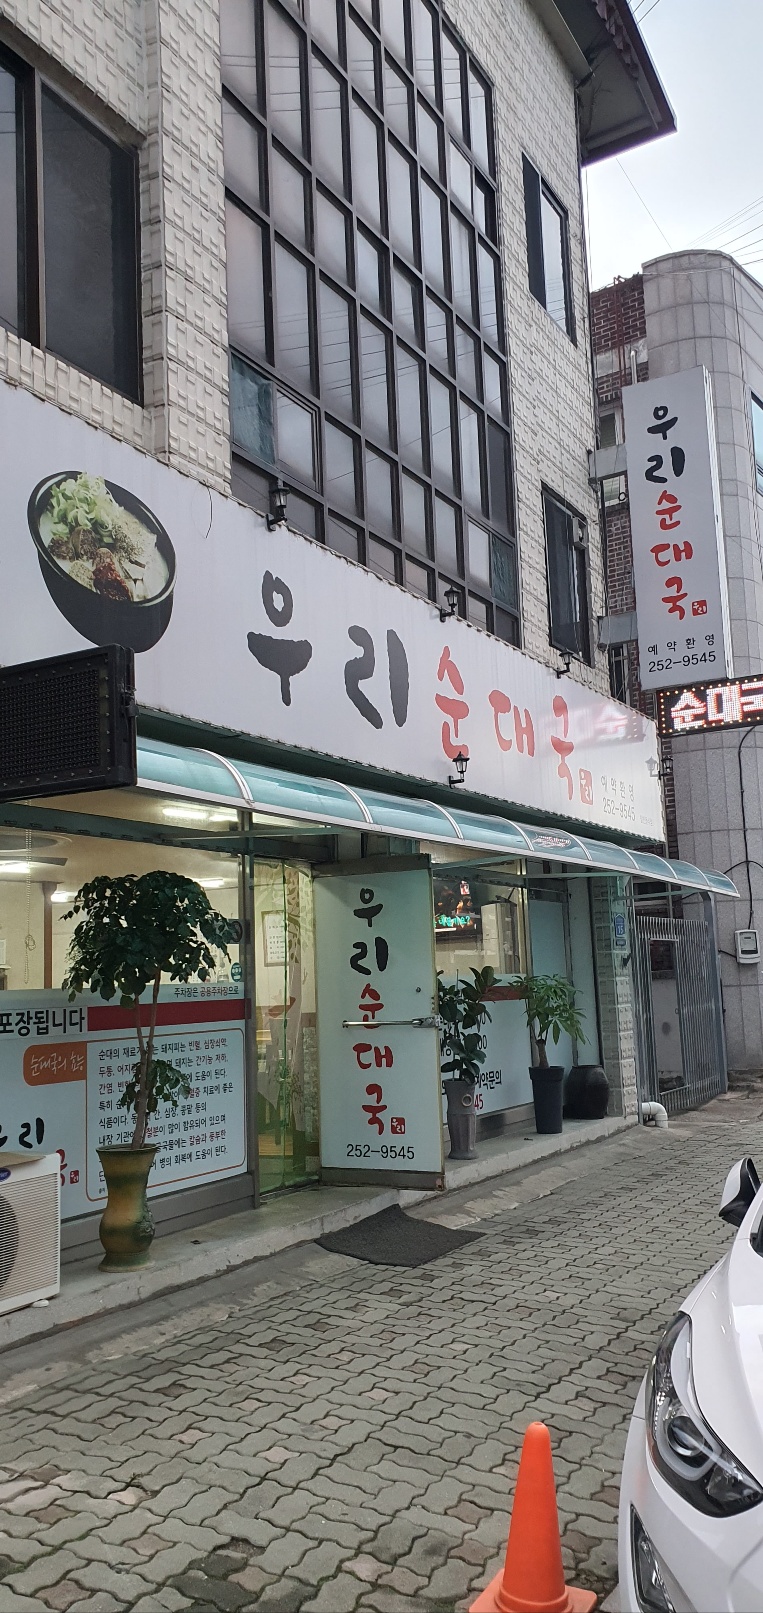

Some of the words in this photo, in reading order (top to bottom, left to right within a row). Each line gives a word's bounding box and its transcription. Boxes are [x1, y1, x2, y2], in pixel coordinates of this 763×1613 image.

[645, 405, 686, 484] 우리
[650, 490, 694, 620] 순대국
[648, 651, 716, 672] 252-9545
[247, 570, 409, 729] 우리
[435, 645, 574, 801] 순대국
[602, 797, 636, 821] 252-9545
[350, 887, 389, 976] 우리
[174, 987, 199, 998] 주차장은
[200, 985, 239, 998] 공용주차장으로
[0, 1007, 86, 1037] 포장됩니다
[98, 1048, 120, 1060] 순대의
[161, 1042, 187, 1053] 돼지피는
[175, 1057, 193, 1069] 돼지는
[195, 1055, 213, 1067] 간기능
[195, 1070, 213, 1082] 도움이
[202, 1083, 221, 1096] 치료에
[98, 1100, 113, 1112] 특히
[194, 1102, 207, 1114] 등의
[98, 1134, 114, 1146] 내장
[167, 1122, 181, 1135] 많이
[182, 1117, 207, 1132] 함유되어
[208, 1114, 226, 1127] 있으며
[188, 1132, 207, 1147] 칼슘과
[208, 1129, 226, 1143] 풍부한
[159, 1155, 172, 1169] 병의
[174, 1152, 193, 1165] 회복에
[195, 1147, 213, 1161] 도움이
[346, 1143, 415, 1160] 252-9545
